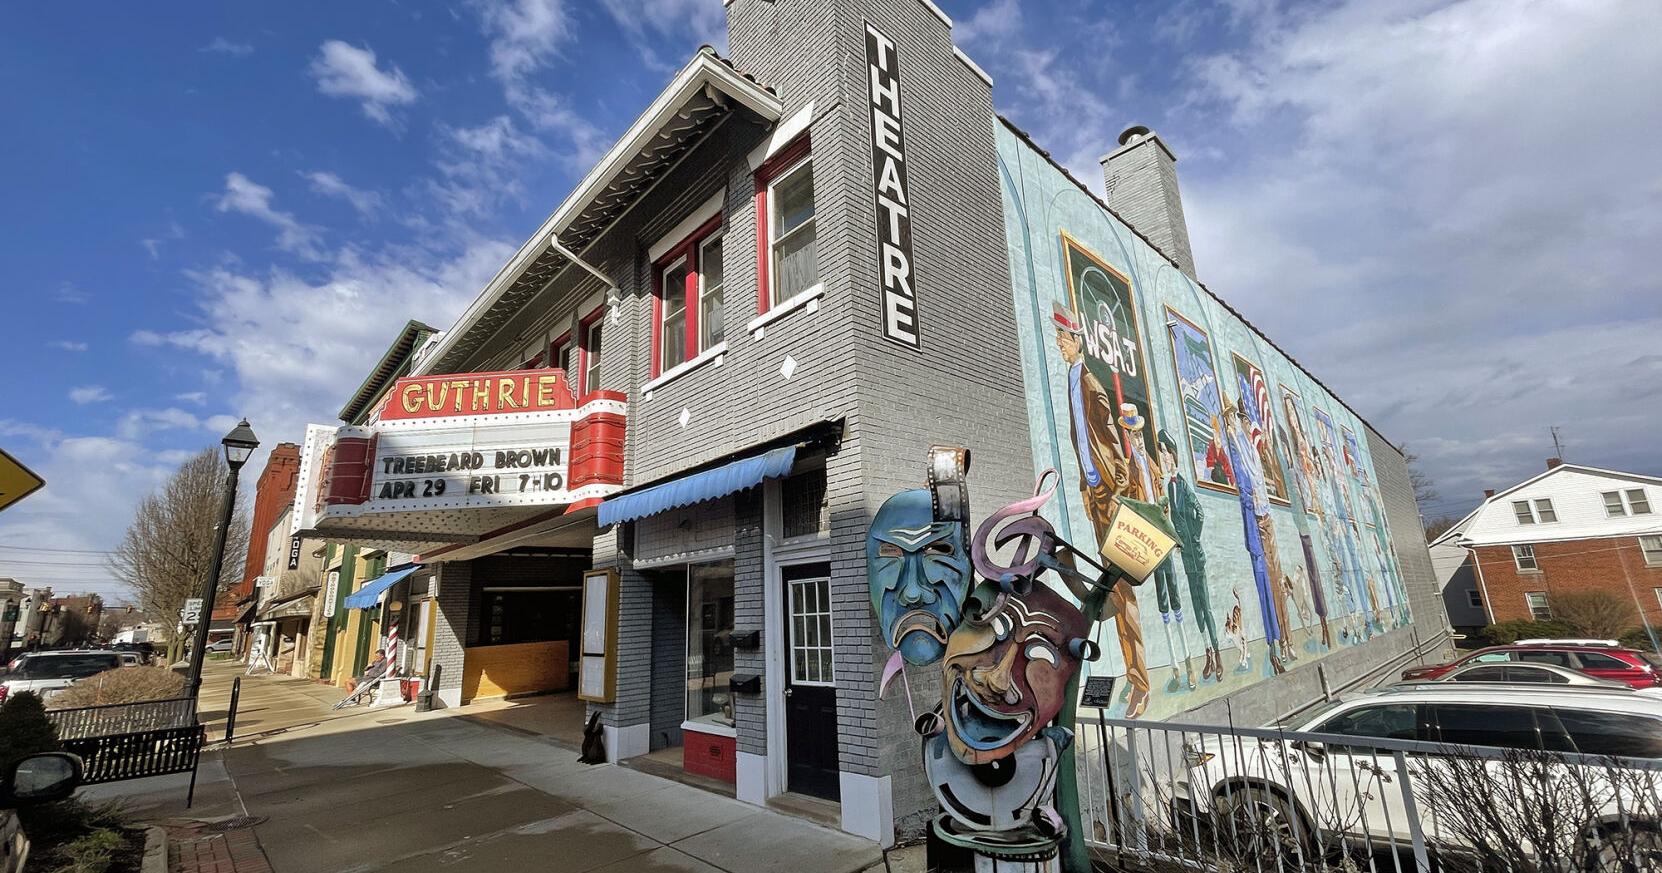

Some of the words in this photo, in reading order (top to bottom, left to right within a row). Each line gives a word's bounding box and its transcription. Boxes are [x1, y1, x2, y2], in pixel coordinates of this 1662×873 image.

[866, 25, 915, 344] THEATRE
[1080, 311, 1137, 377] WSAJ
[402, 375, 556, 413] GUTHRIE
[383, 452, 484, 474] TREEBEARD
[495, 448, 561, 469] BROWN
[379, 481, 416, 499] APR
[423, 478, 446, 498] 29
[470, 475, 500, 495] FRI
[1116, 520, 1163, 559] PARKING
[186, 611, 200, 621] 2
